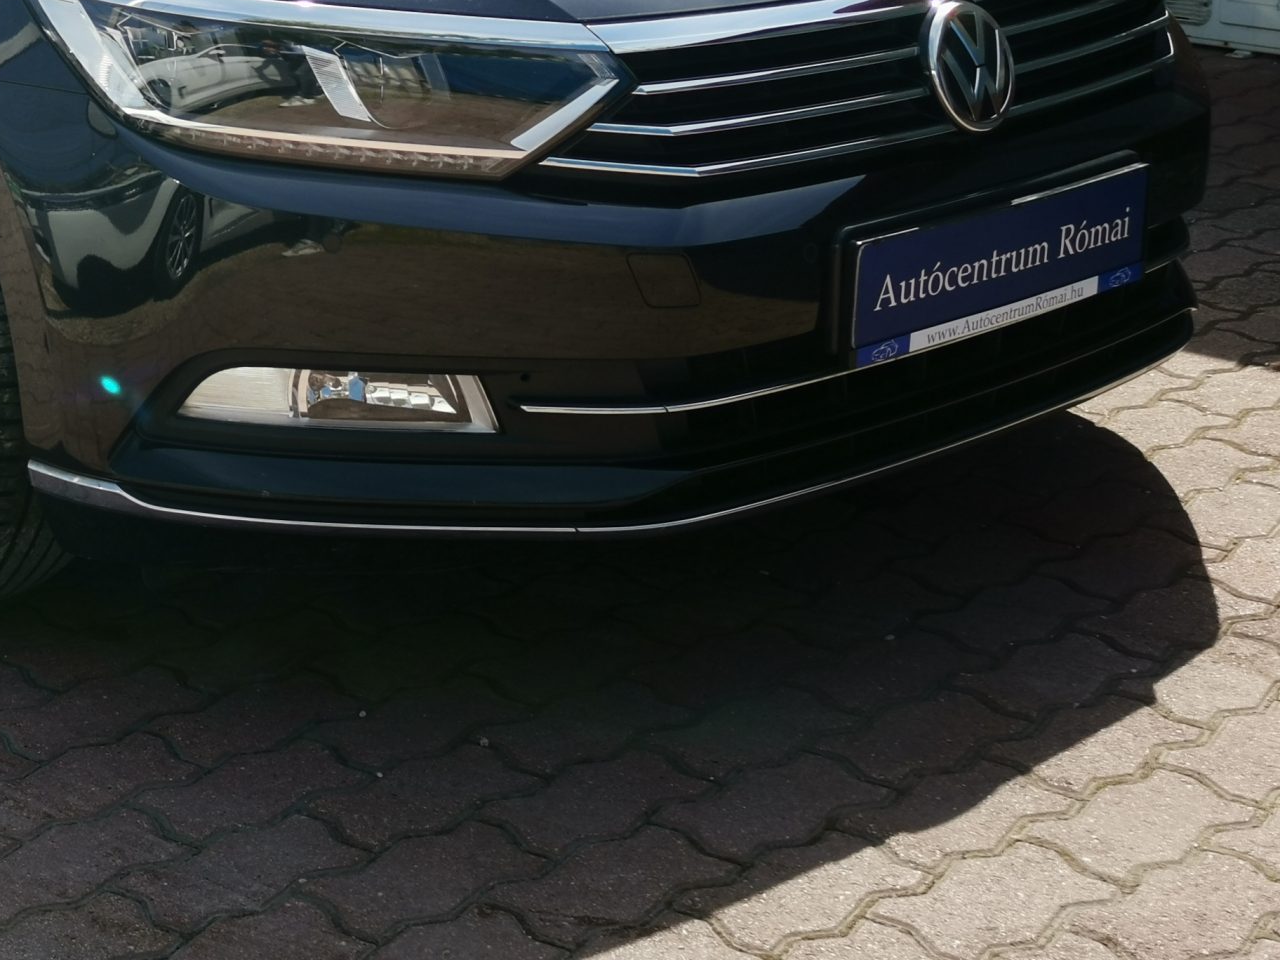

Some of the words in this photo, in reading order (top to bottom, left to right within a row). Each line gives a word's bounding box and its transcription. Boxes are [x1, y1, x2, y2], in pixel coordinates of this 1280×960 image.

[873, 240, 1049, 311] Autócentrum
[1058, 206, 1131, 258] Római
[927, 285, 1085, 345] www.AutócentrumRómai.hu
